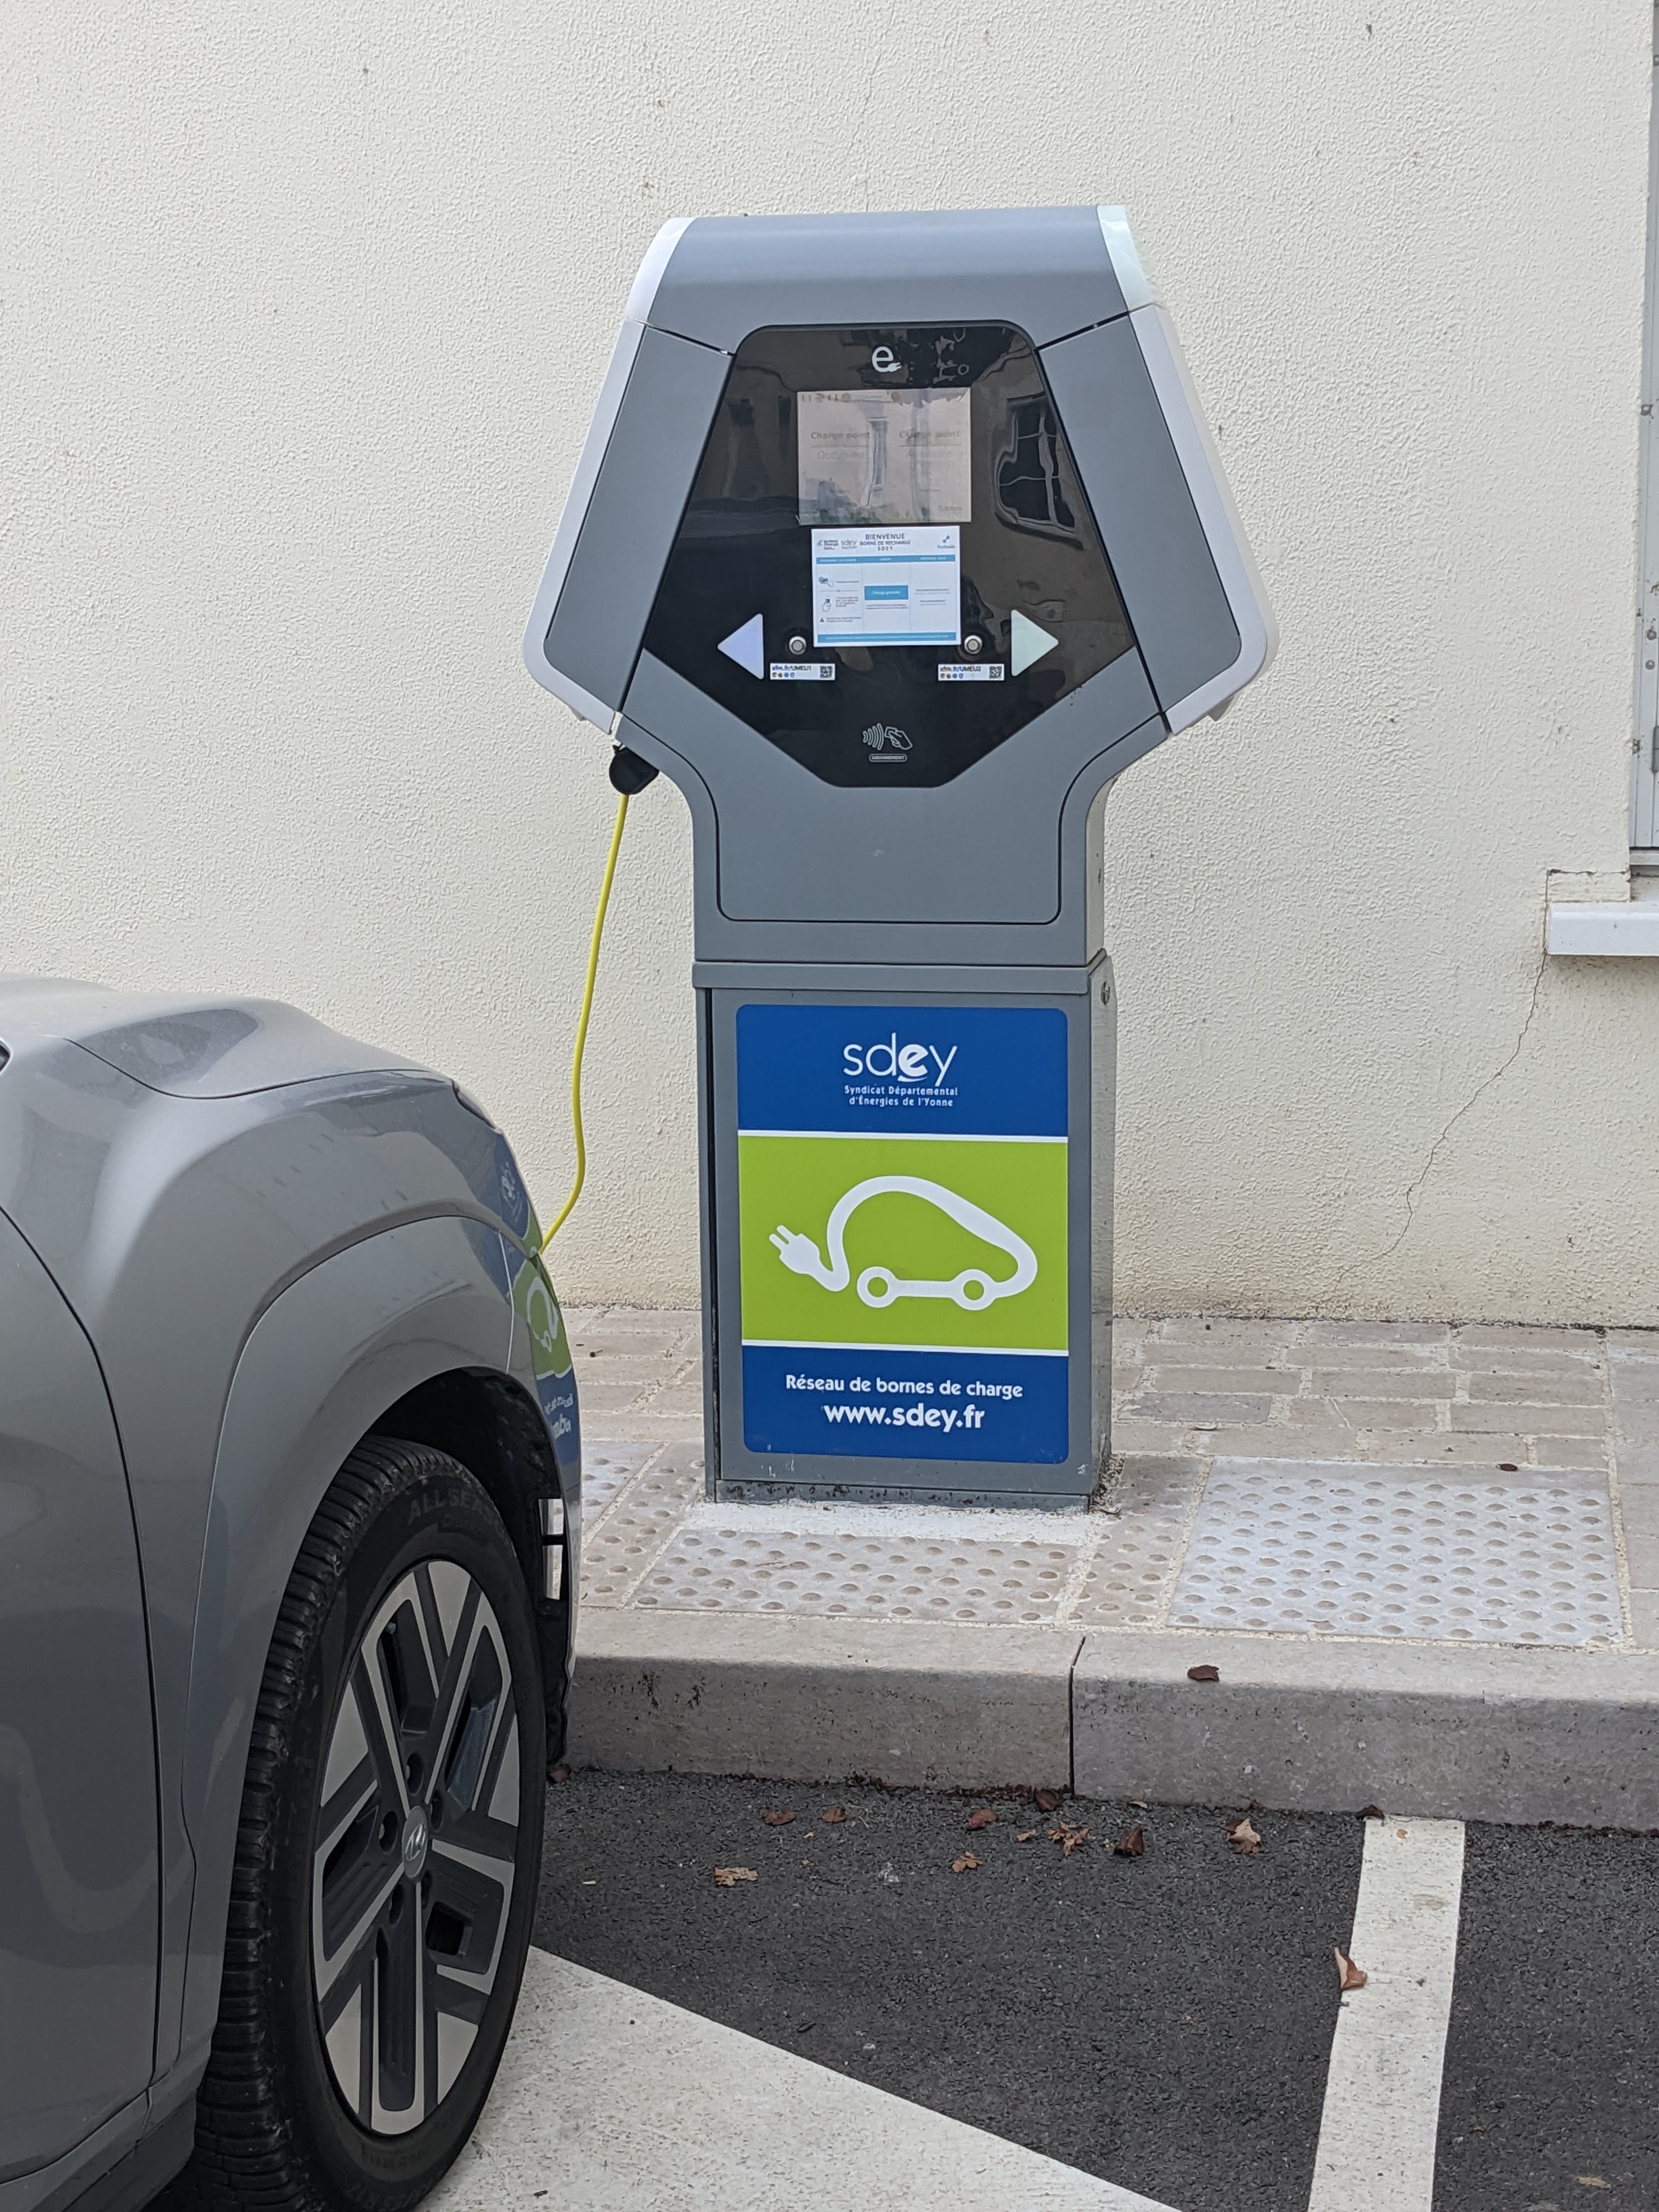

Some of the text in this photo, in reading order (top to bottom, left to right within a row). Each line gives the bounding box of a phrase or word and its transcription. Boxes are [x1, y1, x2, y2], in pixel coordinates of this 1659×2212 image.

[843, 1032, 958, 1087] sdey
[844, 1085, 958, 1096] Syndicat Départemental
[849, 1094, 953, 1108] d'Énergies de l'Yonne
[786, 1374, 1024, 1400] Réseau de bornes de charge
[823, 1402, 986, 1432] www.sdey.fr
